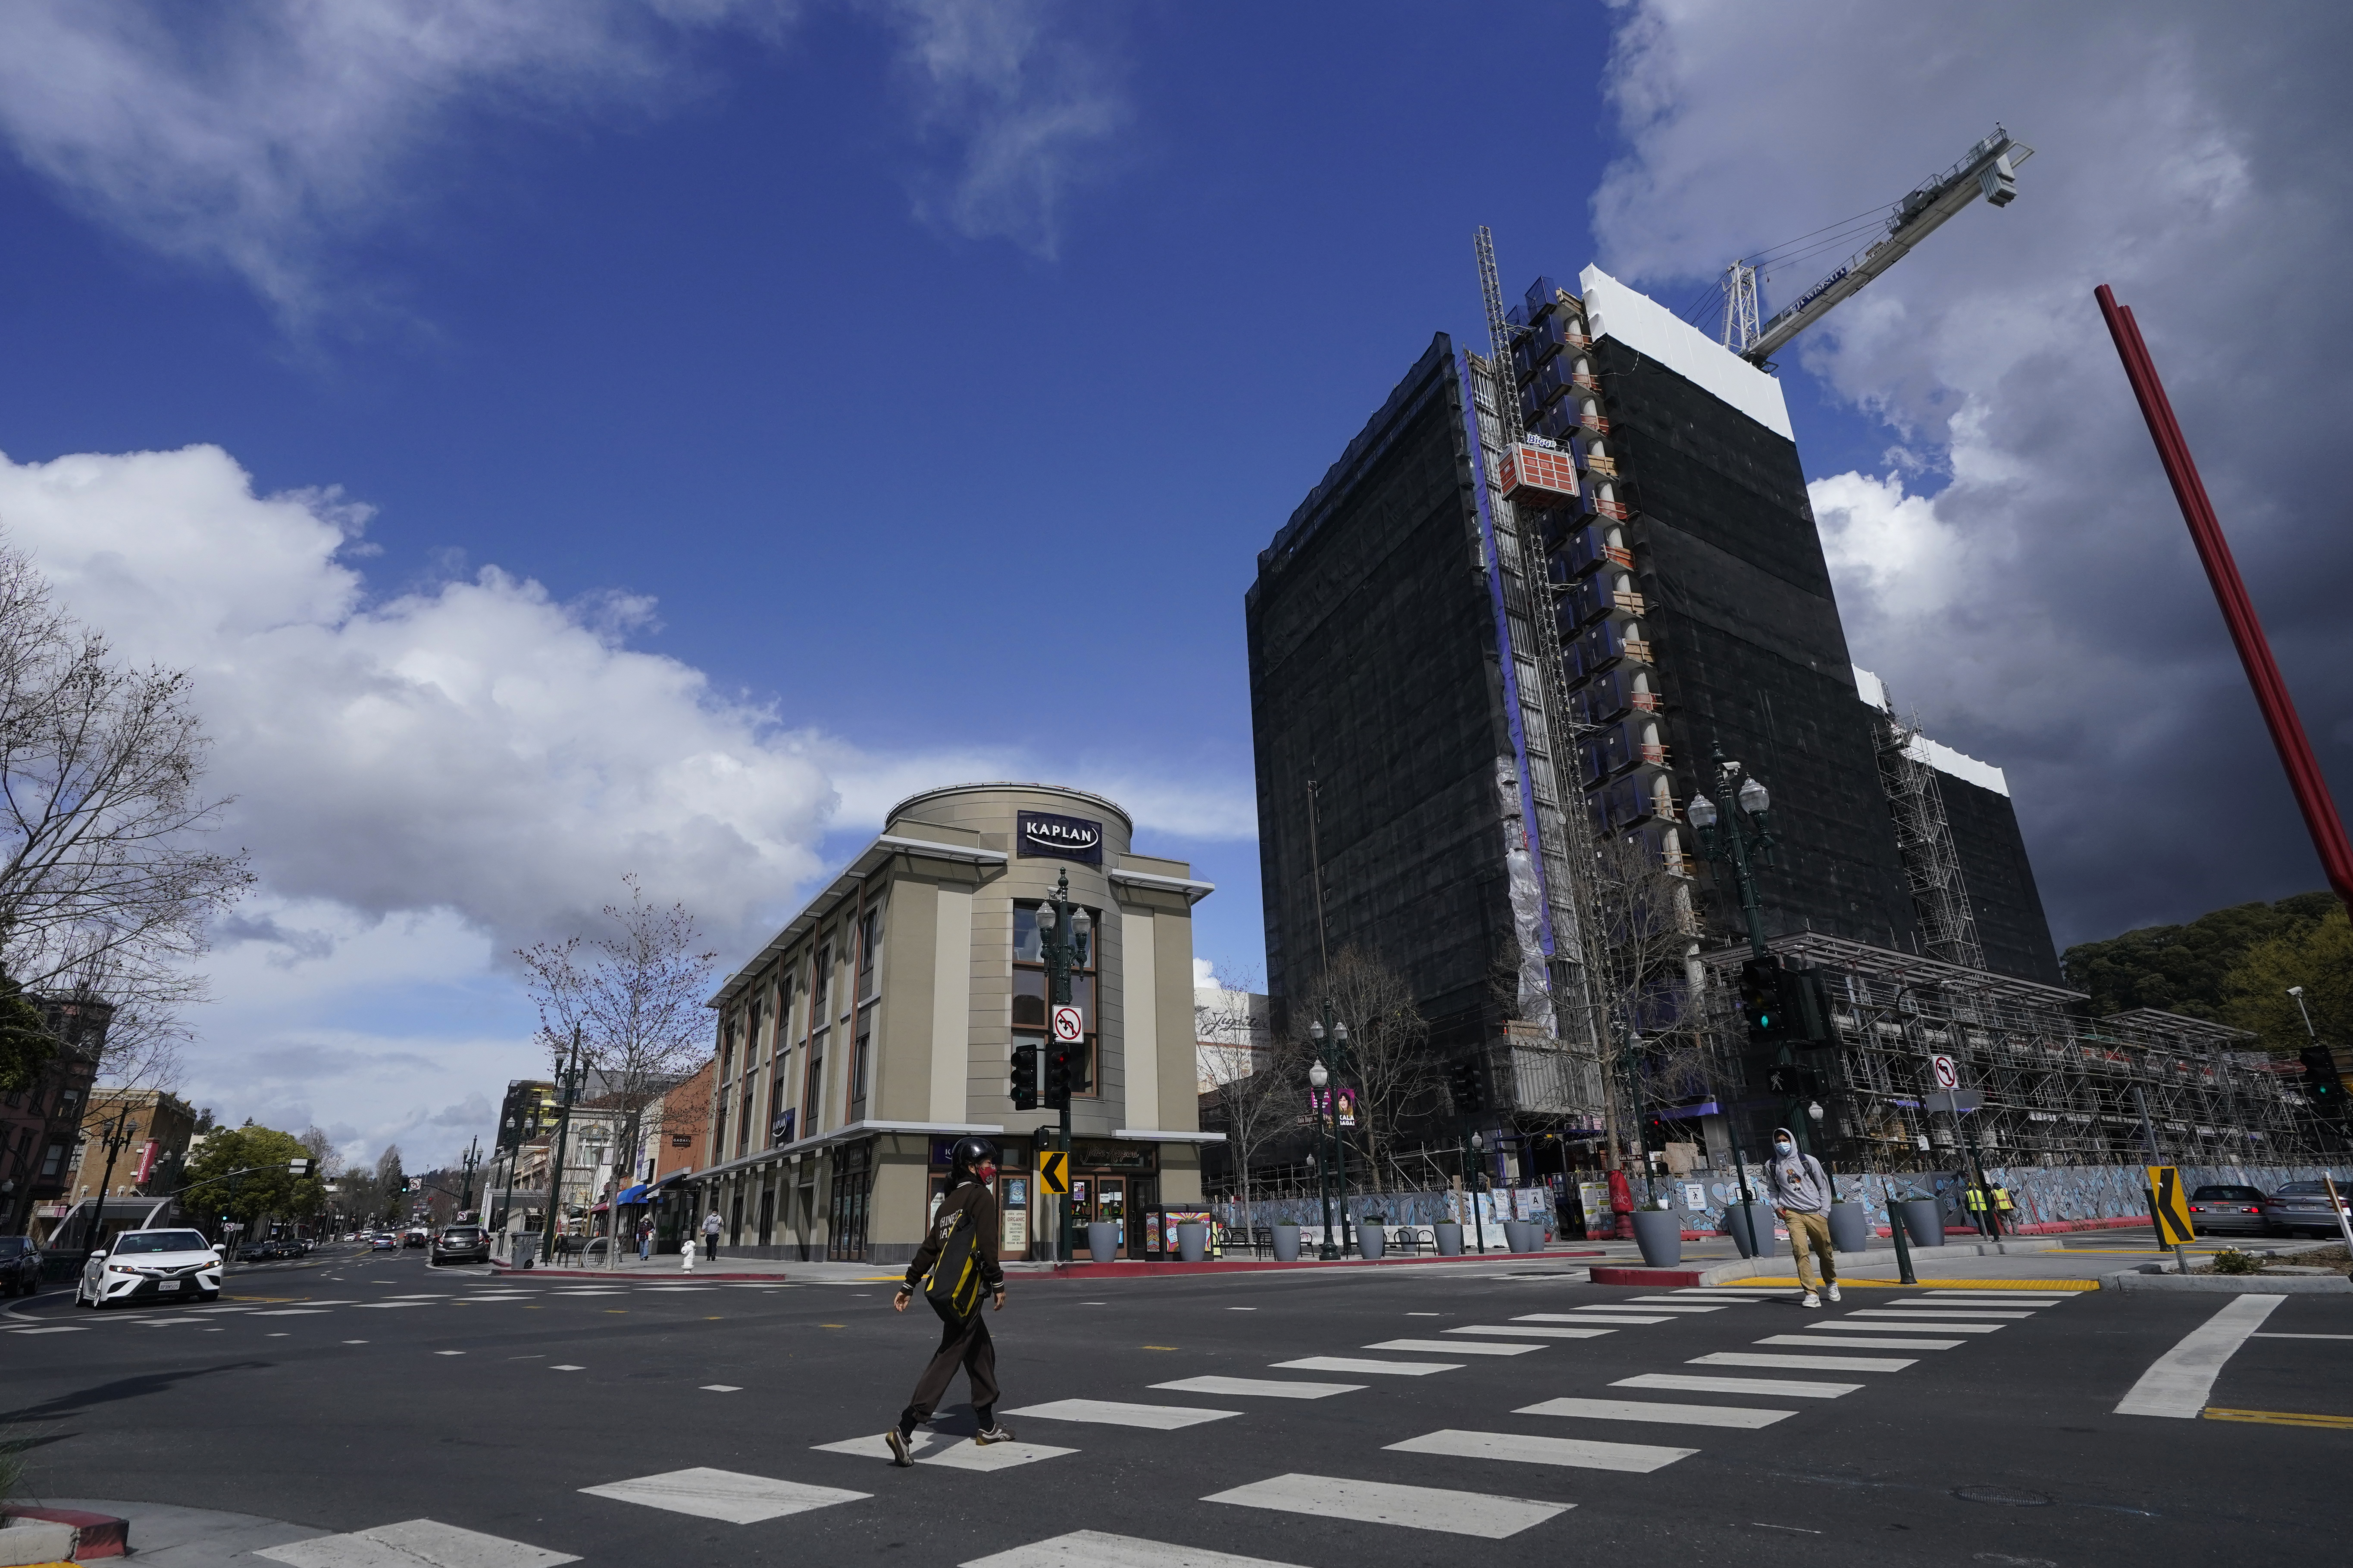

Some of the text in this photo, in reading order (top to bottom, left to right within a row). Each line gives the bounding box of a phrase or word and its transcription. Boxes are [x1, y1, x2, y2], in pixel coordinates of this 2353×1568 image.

[1026, 822, 1091, 842] KAPLAN
[773, 1118, 785, 1131] KAPLAN
[1080, 1144, 1139, 1163] Juice Appeal
[138, 1149, 149, 1181] BOOKS
